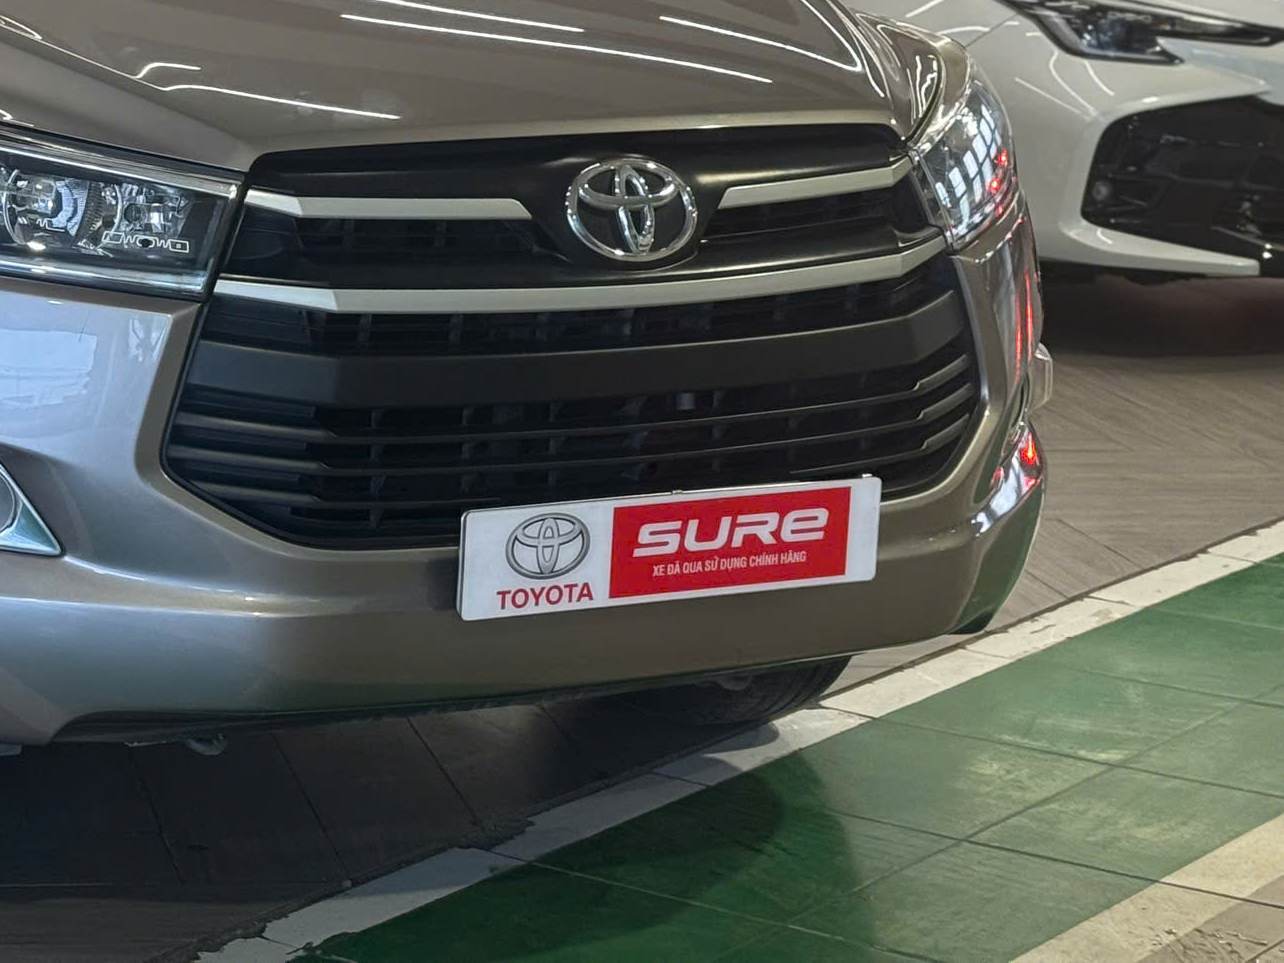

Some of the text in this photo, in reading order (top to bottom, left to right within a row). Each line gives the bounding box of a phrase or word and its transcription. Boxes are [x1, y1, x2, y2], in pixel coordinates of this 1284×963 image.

[652, 564, 665, 577] XE
[682, 560, 703, 574] QUA
[749, 552, 779, 567] CHÍNH
[496, 582, 594, 610] TOYOTA
